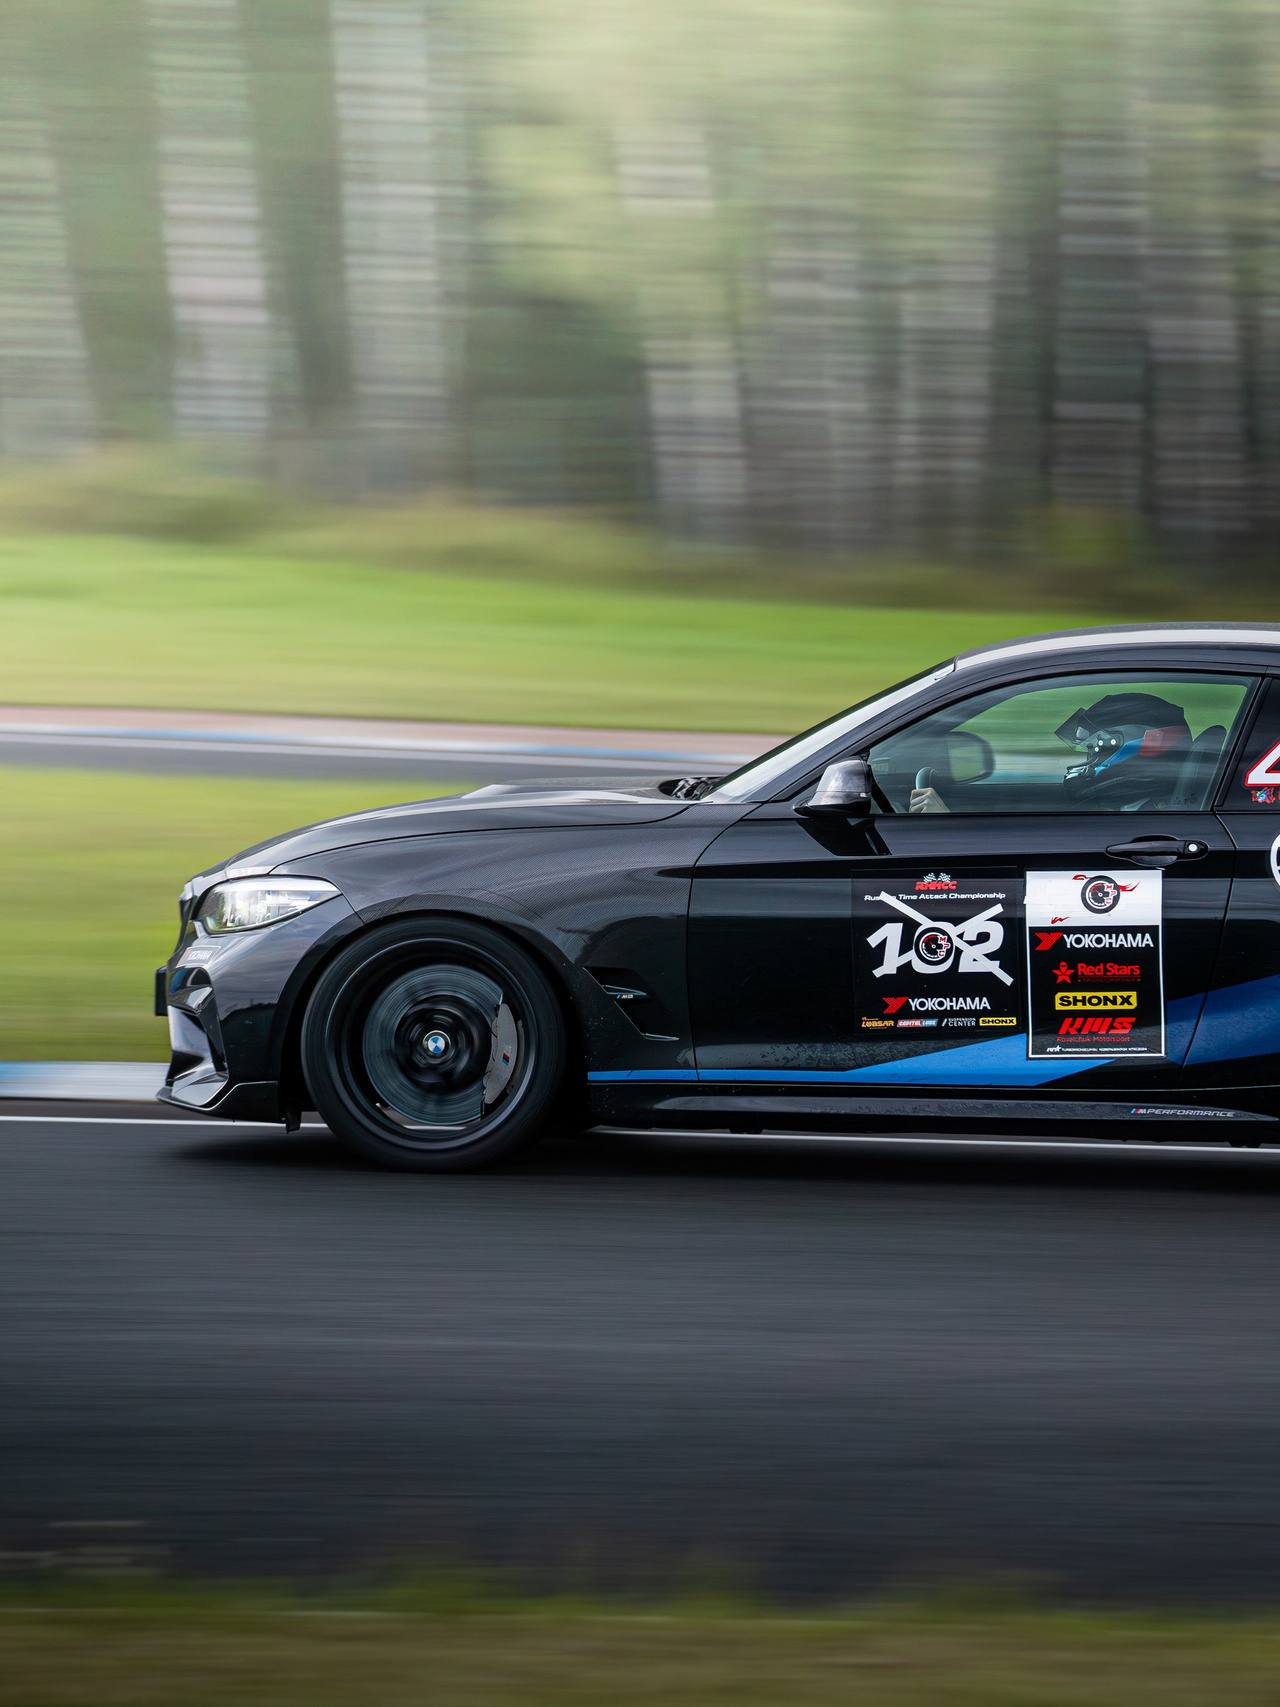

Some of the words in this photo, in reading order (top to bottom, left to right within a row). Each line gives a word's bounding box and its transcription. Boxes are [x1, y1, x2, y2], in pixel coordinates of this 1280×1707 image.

[949, 892, 1006, 900] Championship
[1063, 933, 1154, 948] YOKOHAMA
[1077, 963, 1104, 975] Red
[1106, 963, 1140, 976] Stars
[908, 997, 991, 1011] YOKOHAMA
[1058, 995, 1134, 1007] SHONX
[1058, 1017, 1137, 1035] KMS
